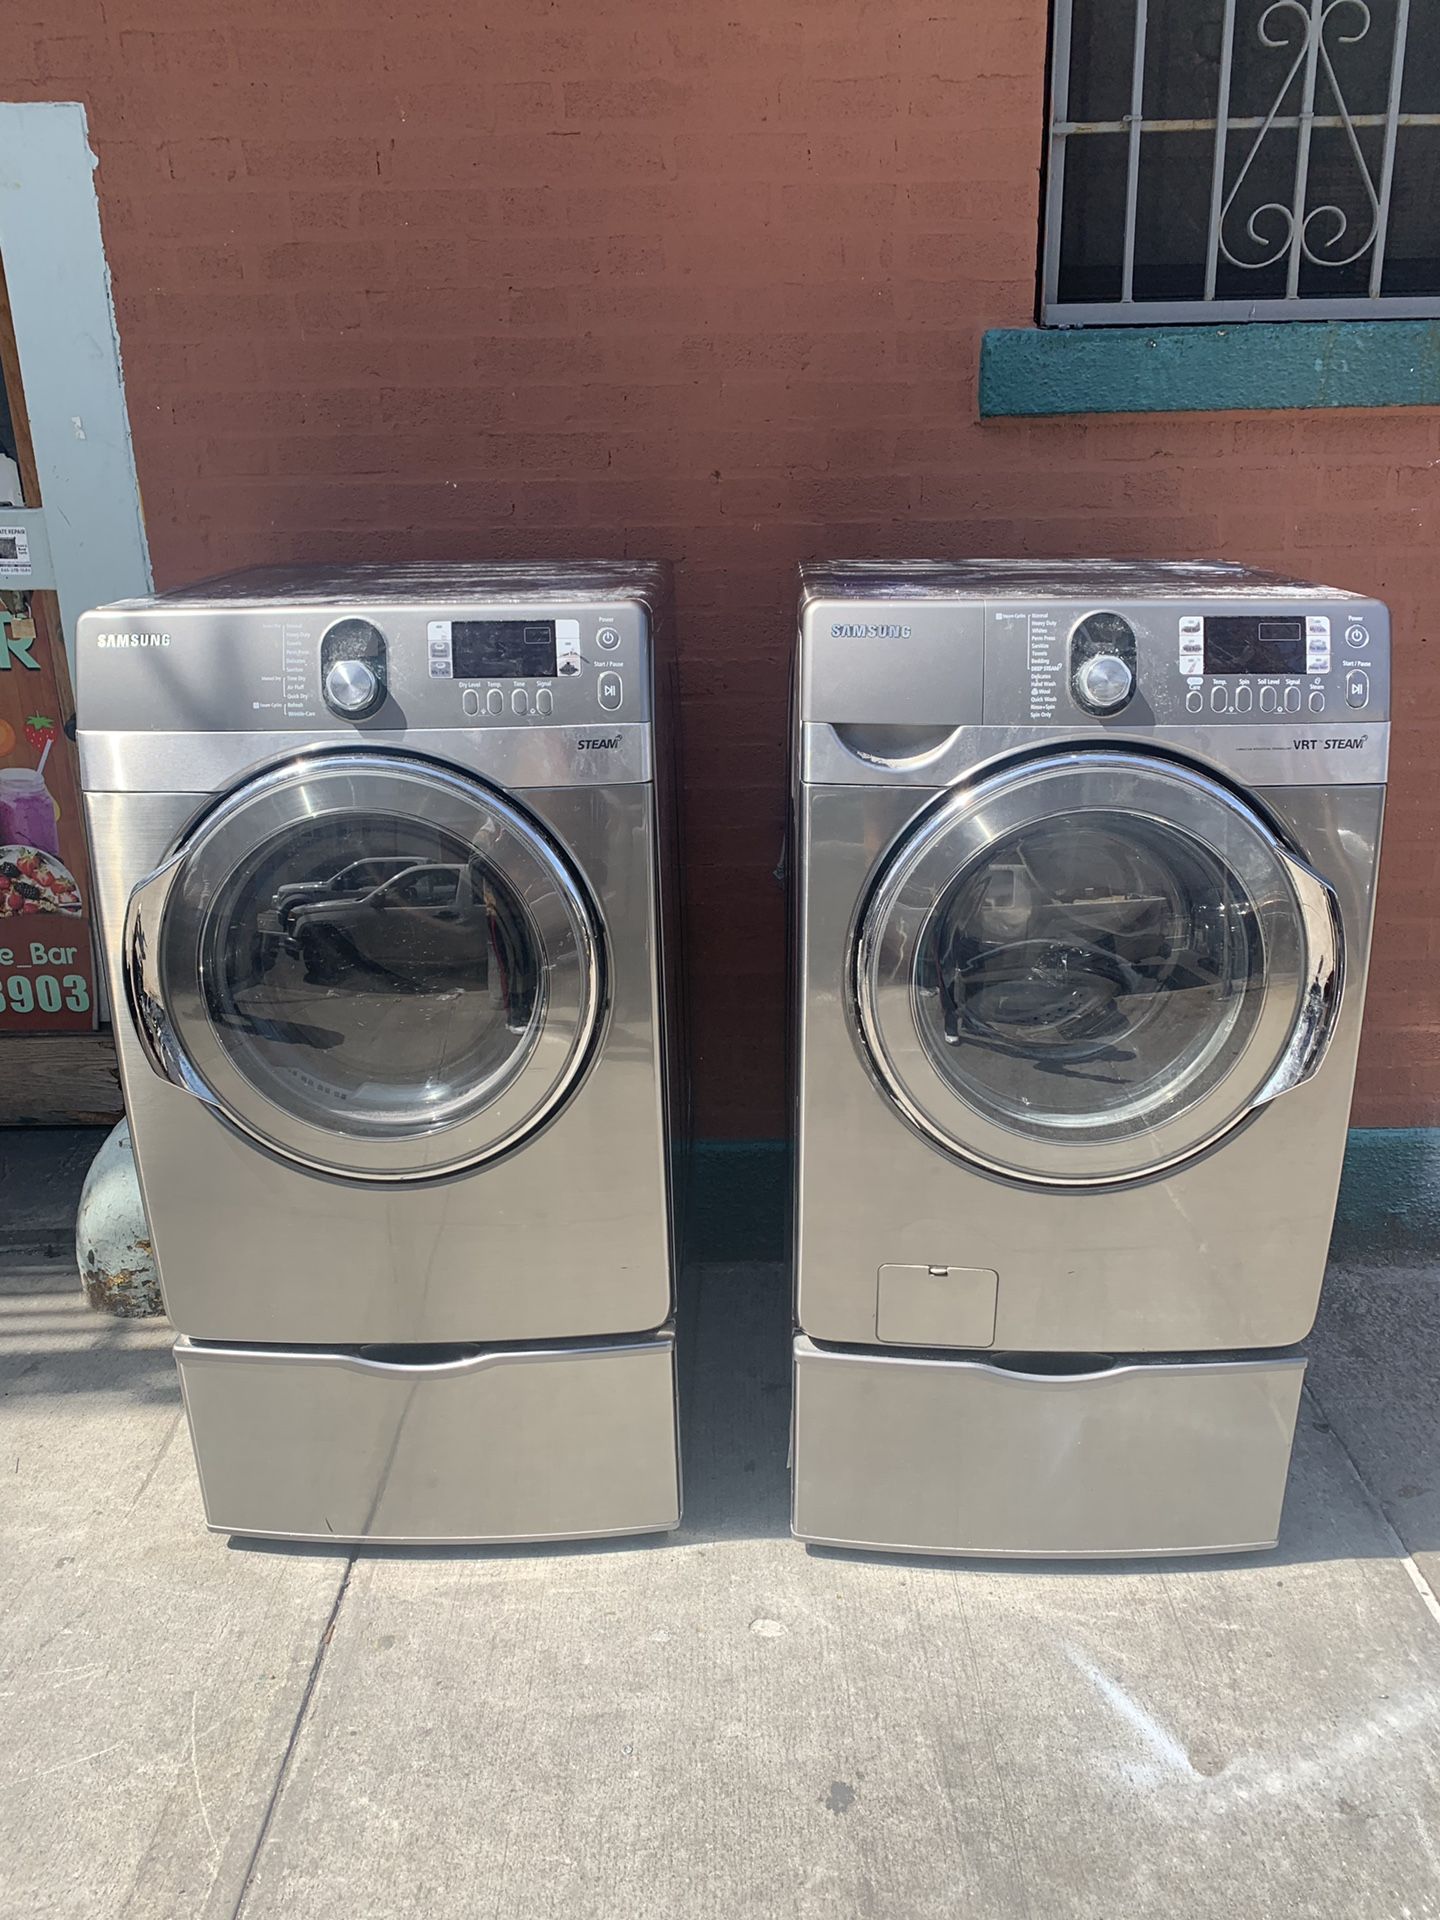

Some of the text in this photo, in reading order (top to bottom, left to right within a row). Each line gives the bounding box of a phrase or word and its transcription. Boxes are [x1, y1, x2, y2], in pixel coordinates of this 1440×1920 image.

[831, 624, 911, 639] SAMSUNG
[97, 633, 171, 648] SAMSUNG
[536, 680, 552, 688] Signal
[578, 738, 618, 750] STEAM
[1294, 739, 1318, 750] VRT
[1324, 738, 1364, 750] STEAM
[0, 974, 89, 1013] 903
